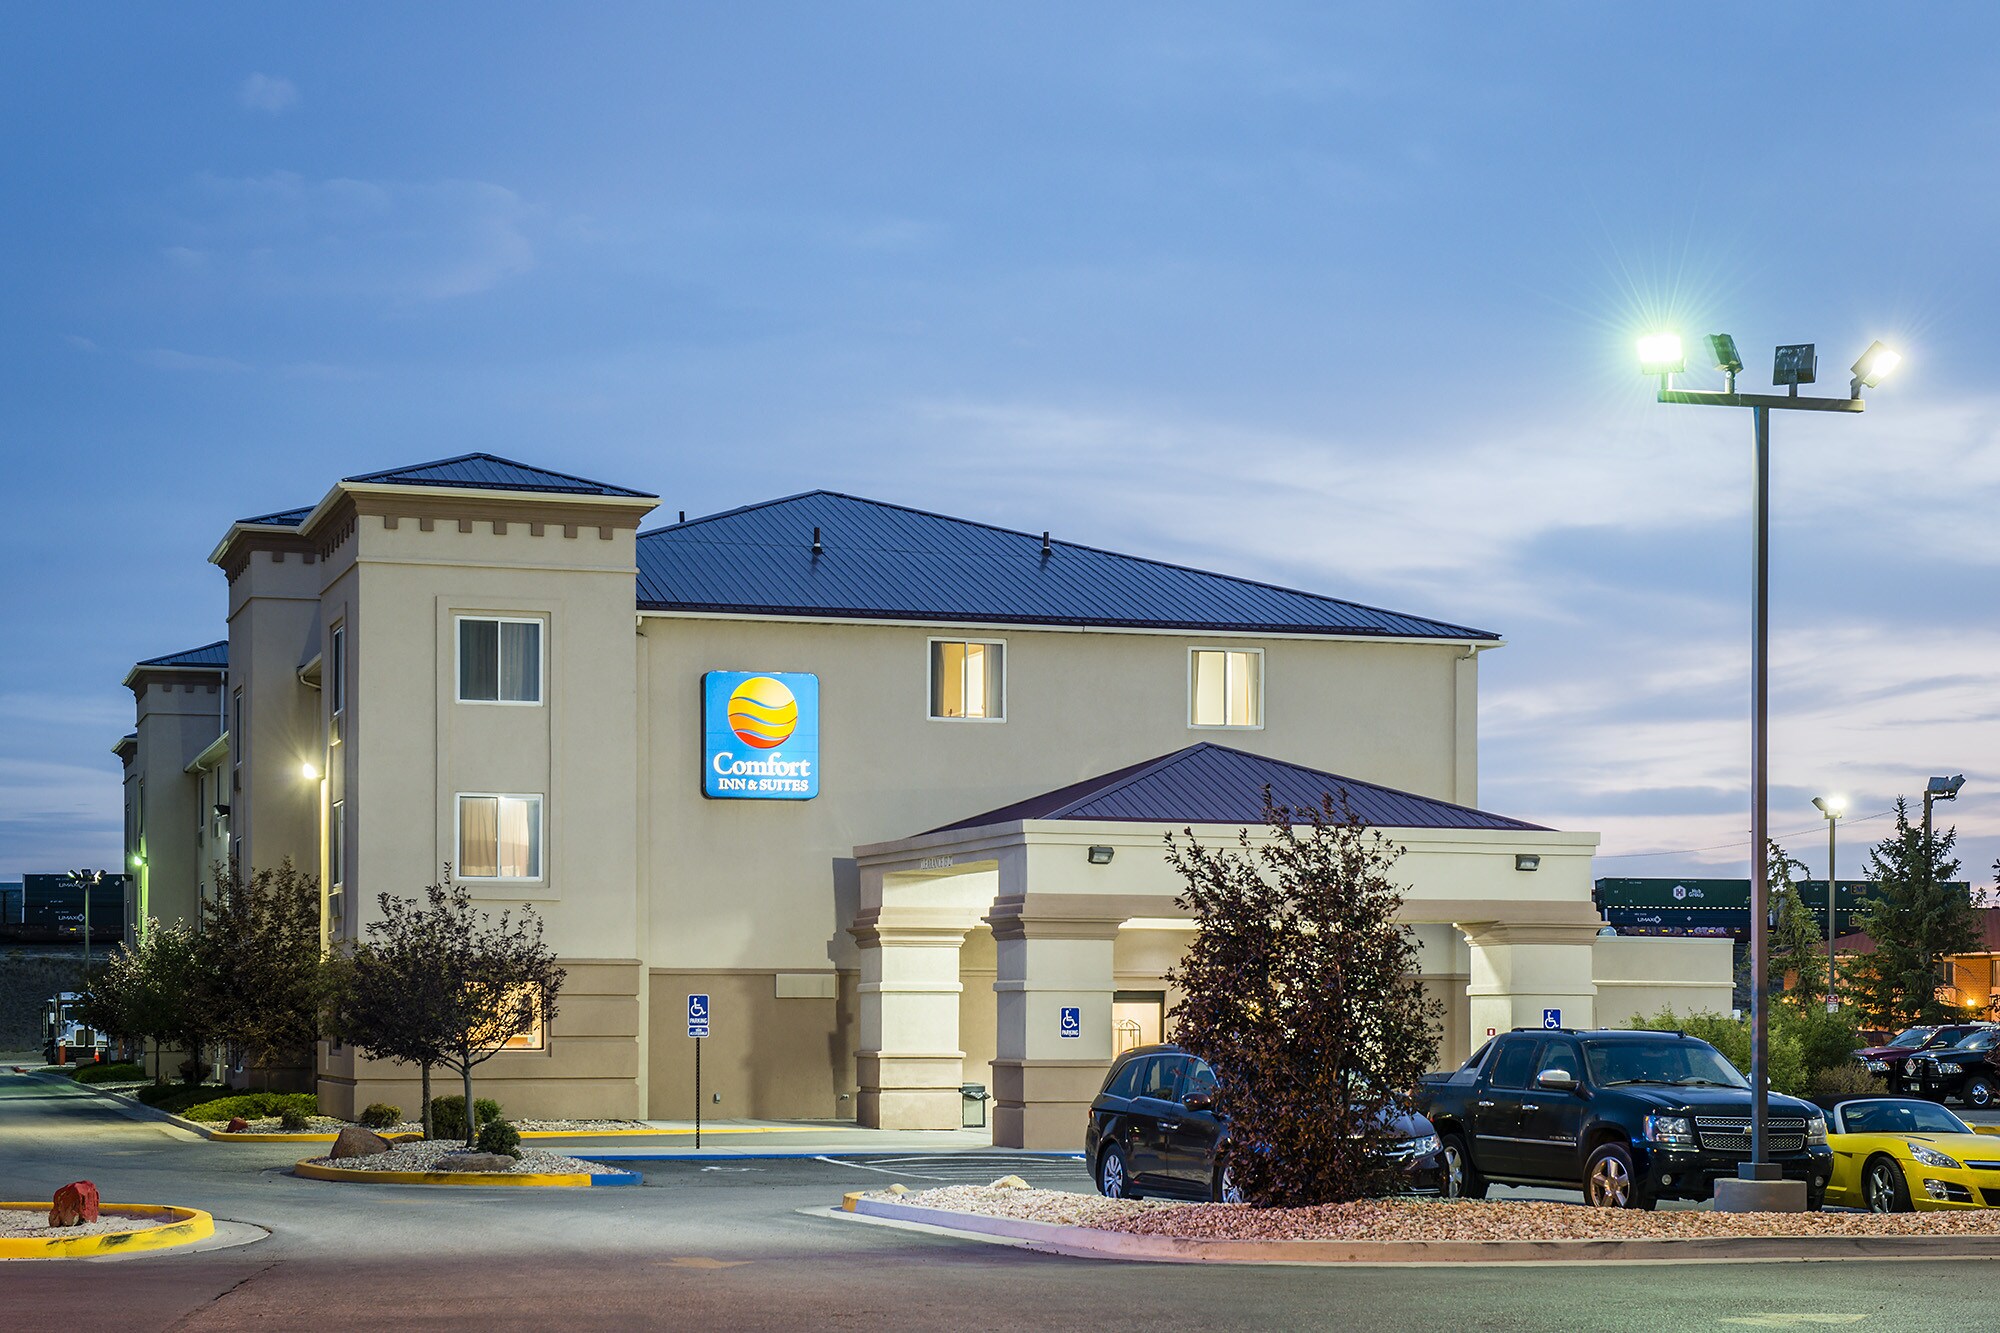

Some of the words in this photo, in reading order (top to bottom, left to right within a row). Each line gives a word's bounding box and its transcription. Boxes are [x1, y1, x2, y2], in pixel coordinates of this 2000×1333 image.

[713, 752, 811, 777] Comfort
[718, 778, 746, 790] INN
[747, 779, 758, 791] &
[759, 779, 809, 792] SUITES
